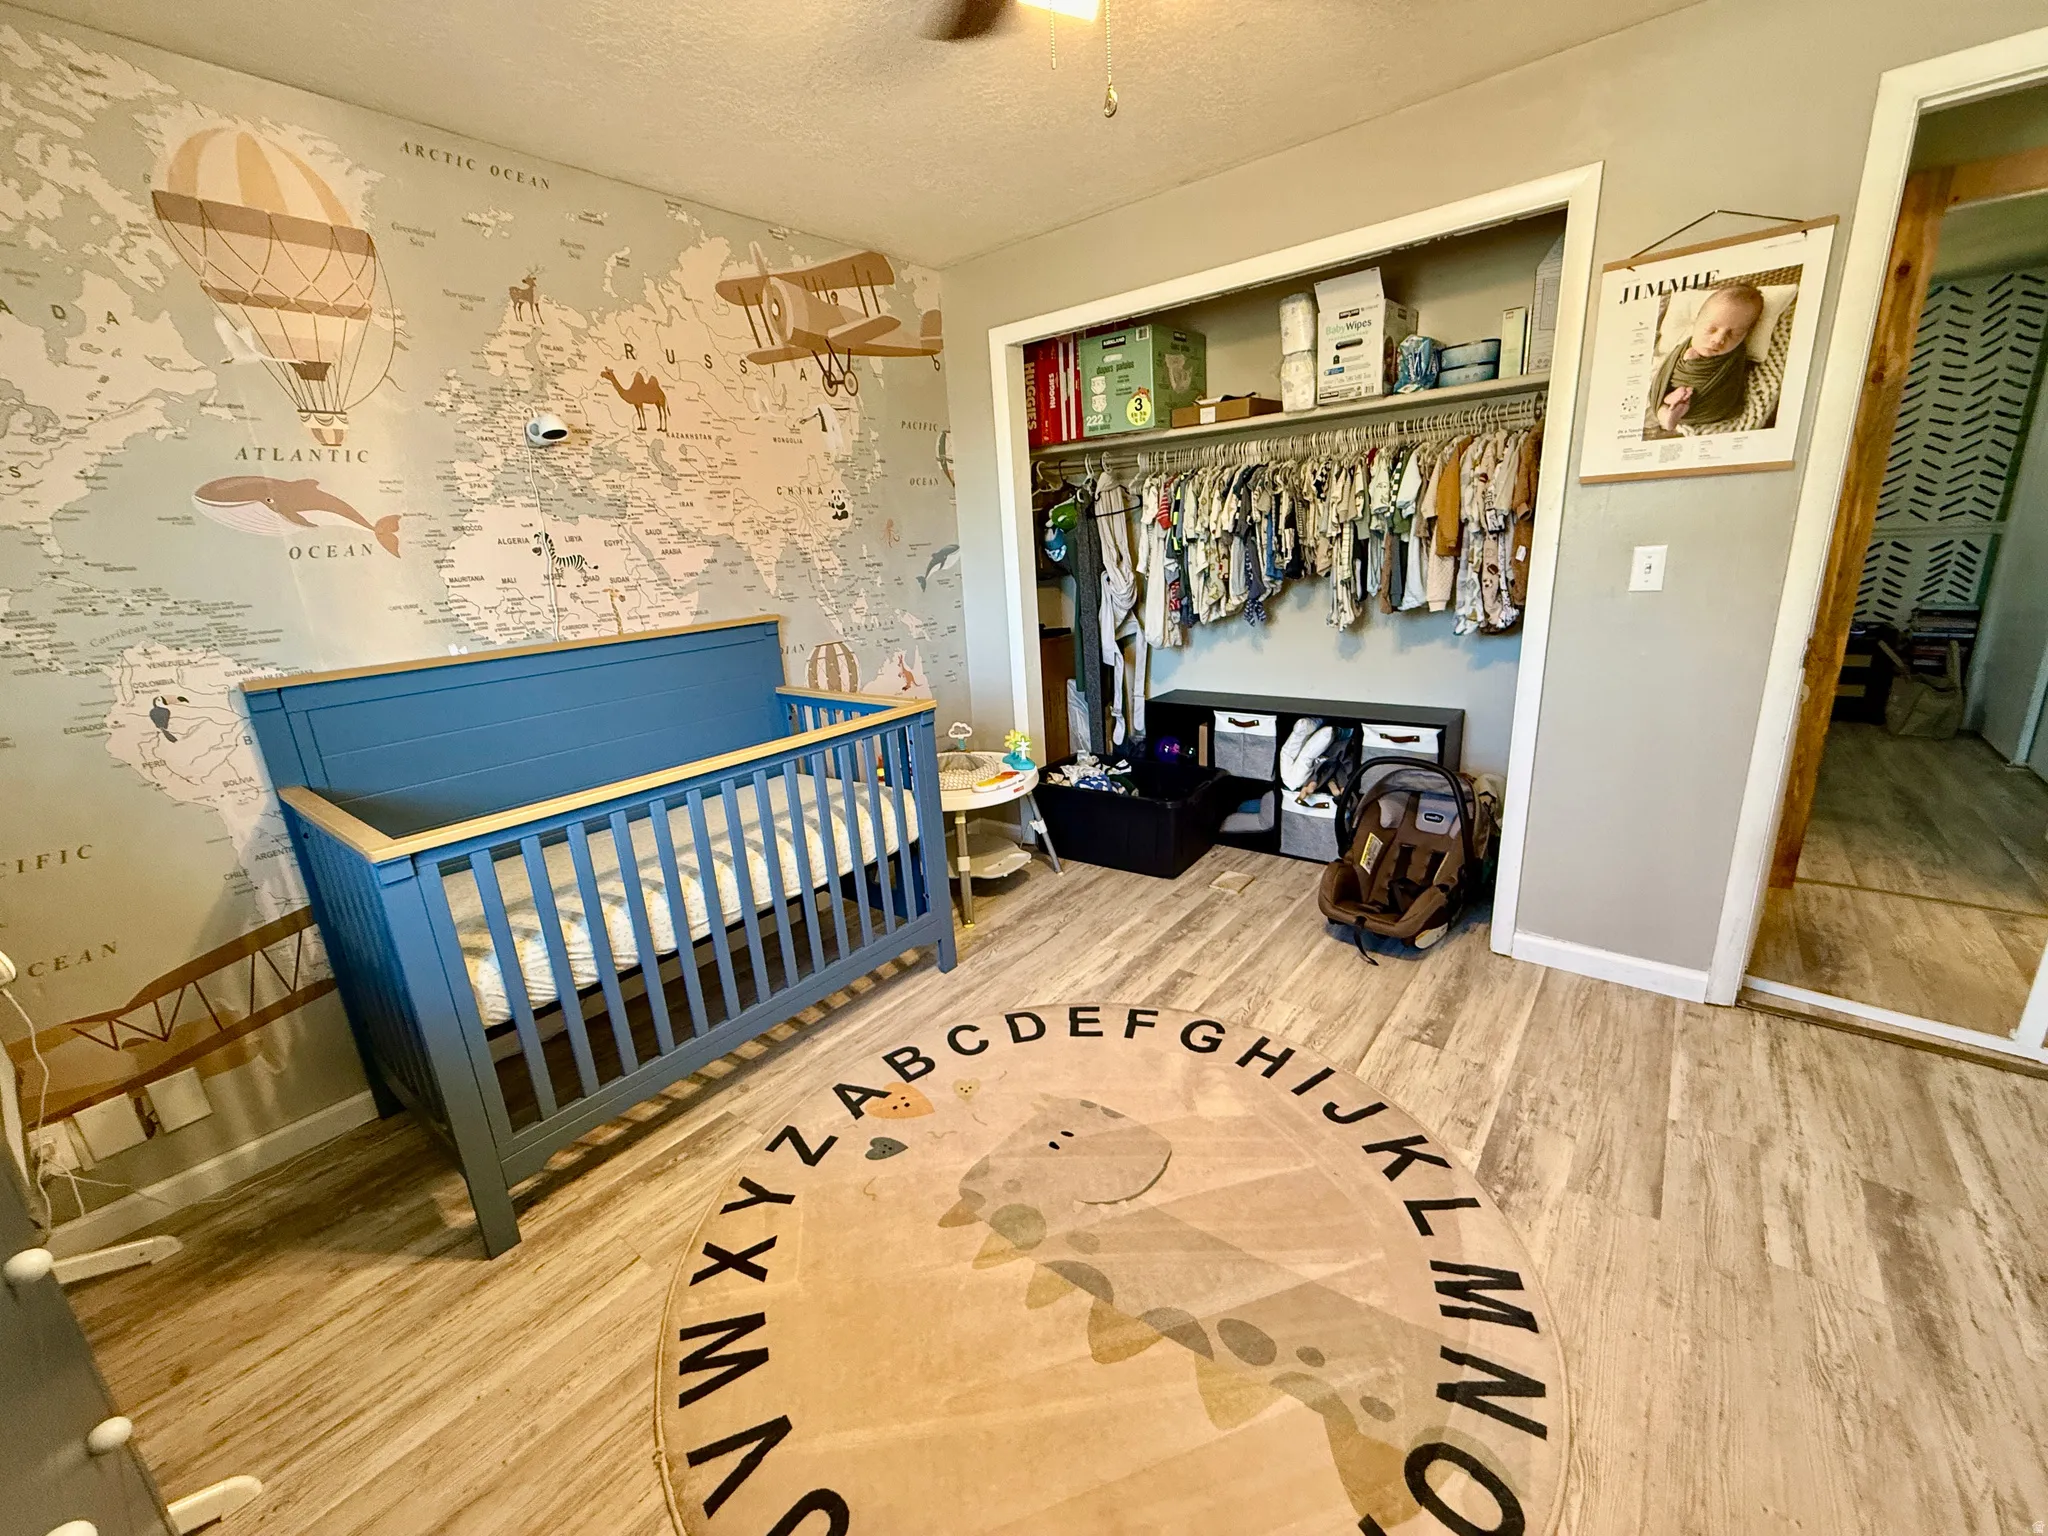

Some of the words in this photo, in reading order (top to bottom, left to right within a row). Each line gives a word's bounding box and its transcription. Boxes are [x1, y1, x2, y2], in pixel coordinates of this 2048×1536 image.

[400, 141, 476, 171] ARCTIC
[489, 164, 551, 190] OCEAN
[1619, 269, 1720, 304] JIMMIE
[1024, 361, 1038, 431] HUGGIES
[1048, 372, 1057, 409] HUGGIES
[1134, 397, 1143, 412] 3
[901, 420, 939, 433] PACIFIC
[1086, 413, 1104, 427] 222
[665, 431, 713, 441] KAZAKHSTAN
[234, 446, 370, 463] ATLANTIC
[909, 477, 940, 487] OCEAN
[776, 486, 824, 496] CHINA
[497, 537, 530, 545] ALGERIA
[604, 539, 624, 547] EGYPT
[289, 543, 374, 560] OCEAN
[448, 575, 486, 583] MAURITANIA
[132, 678, 176, 689] COLOMBIA
[63, 722, 108, 735] ECUADOR
[222, 776, 255, 788] BOLIVIA
[13, 941, 117, 979] CEAN
